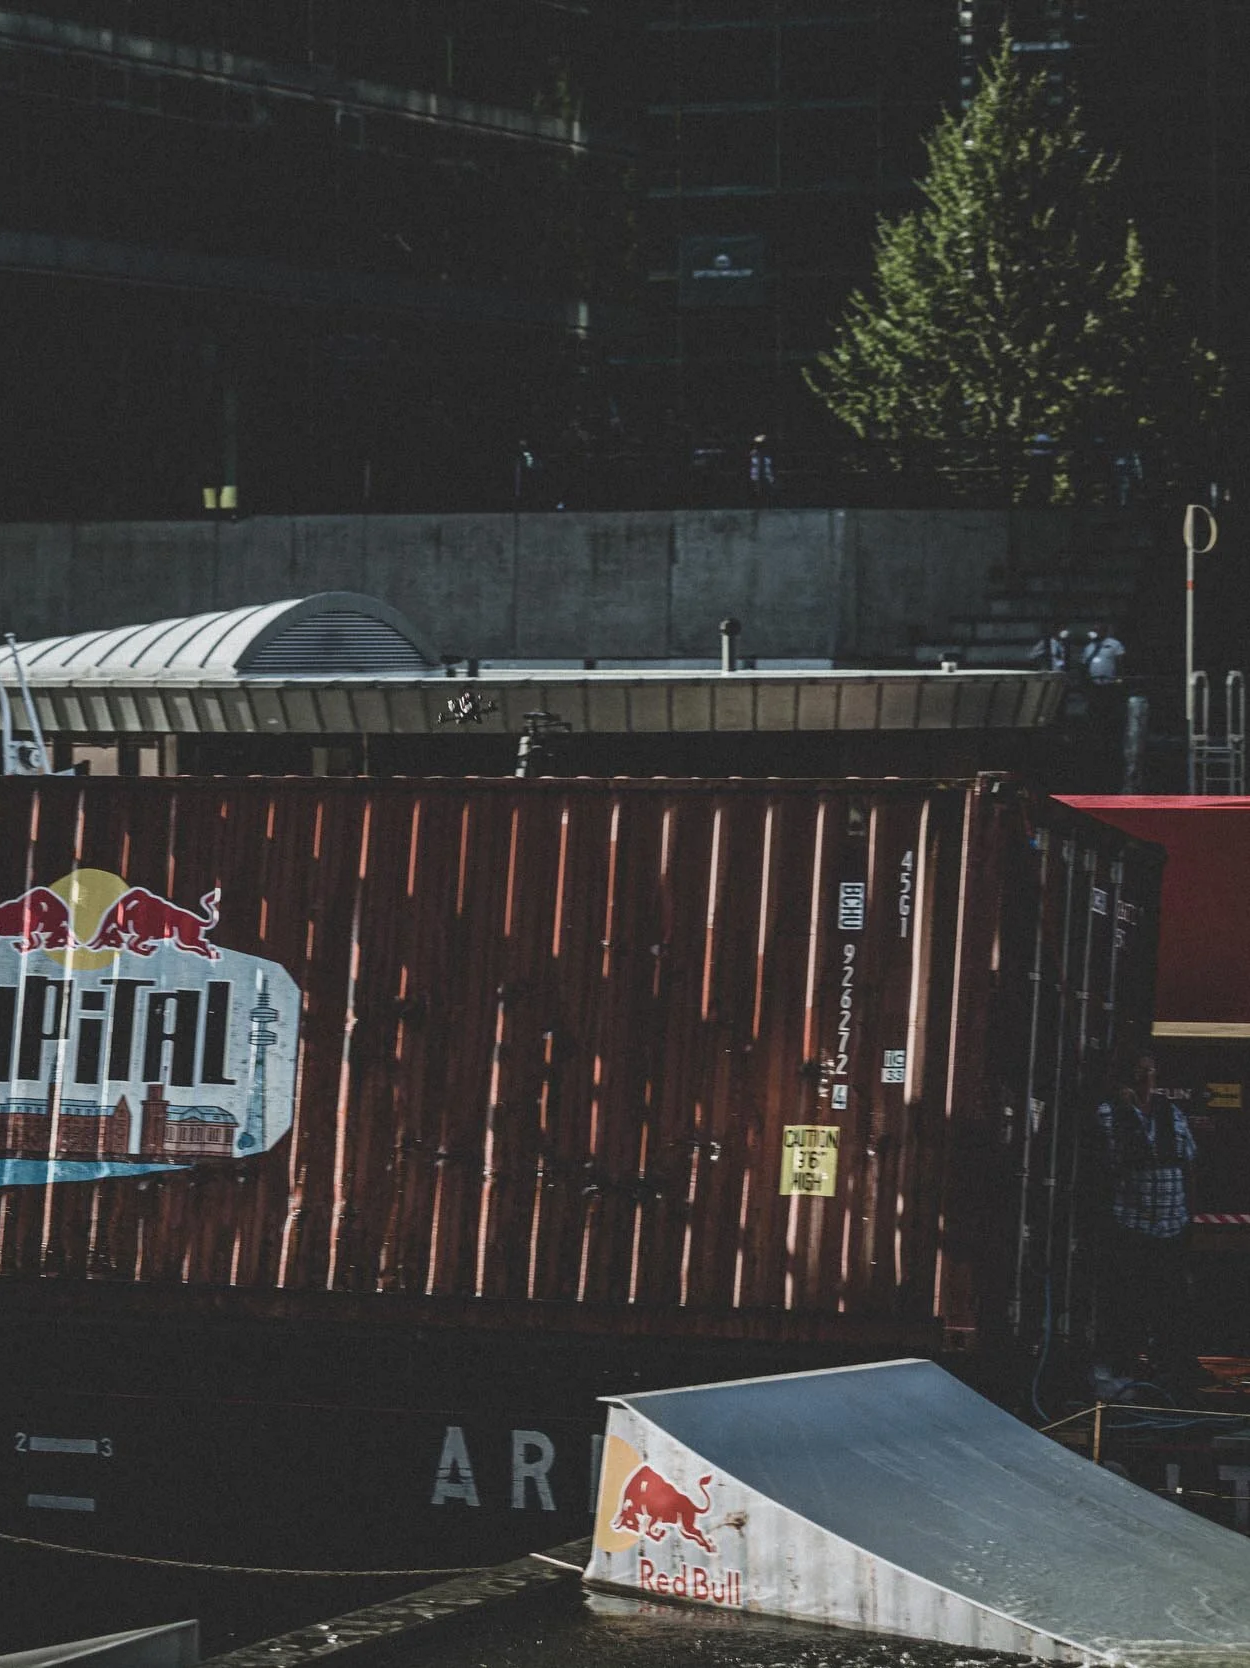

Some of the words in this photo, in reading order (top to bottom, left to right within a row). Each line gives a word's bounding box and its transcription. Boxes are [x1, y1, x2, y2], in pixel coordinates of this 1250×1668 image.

[842, 885, 862, 928] BCHU
[835, 943, 856, 1075] 926272
[784, 1129, 839, 1148] CAUTION
[792, 1172, 822, 1191] HIGH
[14, 1432, 27, 1452] 2
[100, 1437, 113, 1457] 3
[639, 1559, 689, 1600] Red
[692, 1565, 742, 1606] Bull
